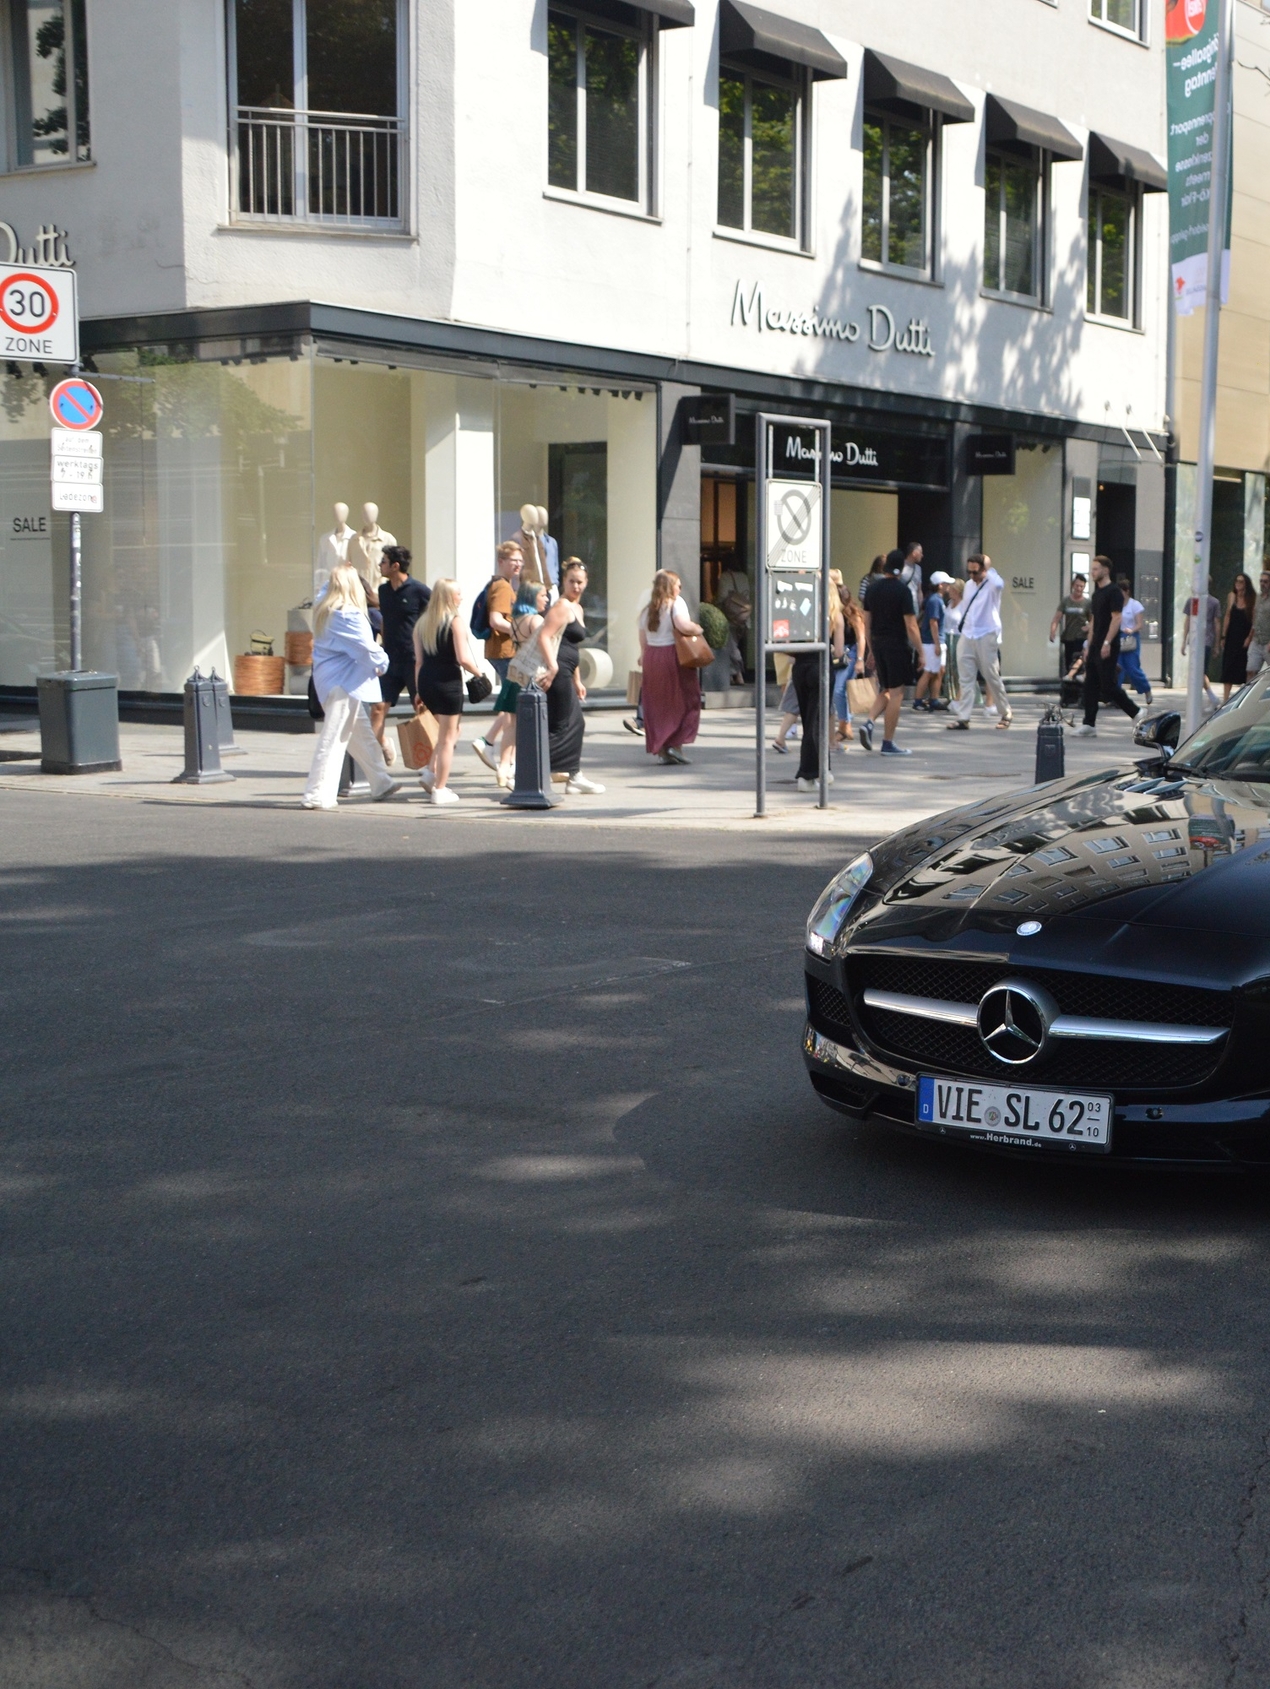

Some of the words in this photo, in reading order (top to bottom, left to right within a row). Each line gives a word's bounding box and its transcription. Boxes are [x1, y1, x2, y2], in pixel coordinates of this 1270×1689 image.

[9, 289, 45, 318] 30
[731, 279, 860, 342] Massimo
[867, 304, 936, 357] Dutti
[5, 336, 53, 354] ZONE
[845, 441, 879, 467] Dutti
[57, 460, 98, 471] werktags
[12, 517, 47, 533] SALE
[781, 550, 807, 564] ZONE
[1012, 576, 1035, 589] SALE
[922, 1103, 929, 1114] D
[938, 1084, 983, 1124] VIE
[1004, 1093, 1040, 1131] SL
[1048, 1098, 1086, 1136] 62
[1087, 1101, 1102, 1113] 03
[1086, 1126, 1100, 1138] 10
[970, 1132, 1043, 1149] www.Herbrand.de
